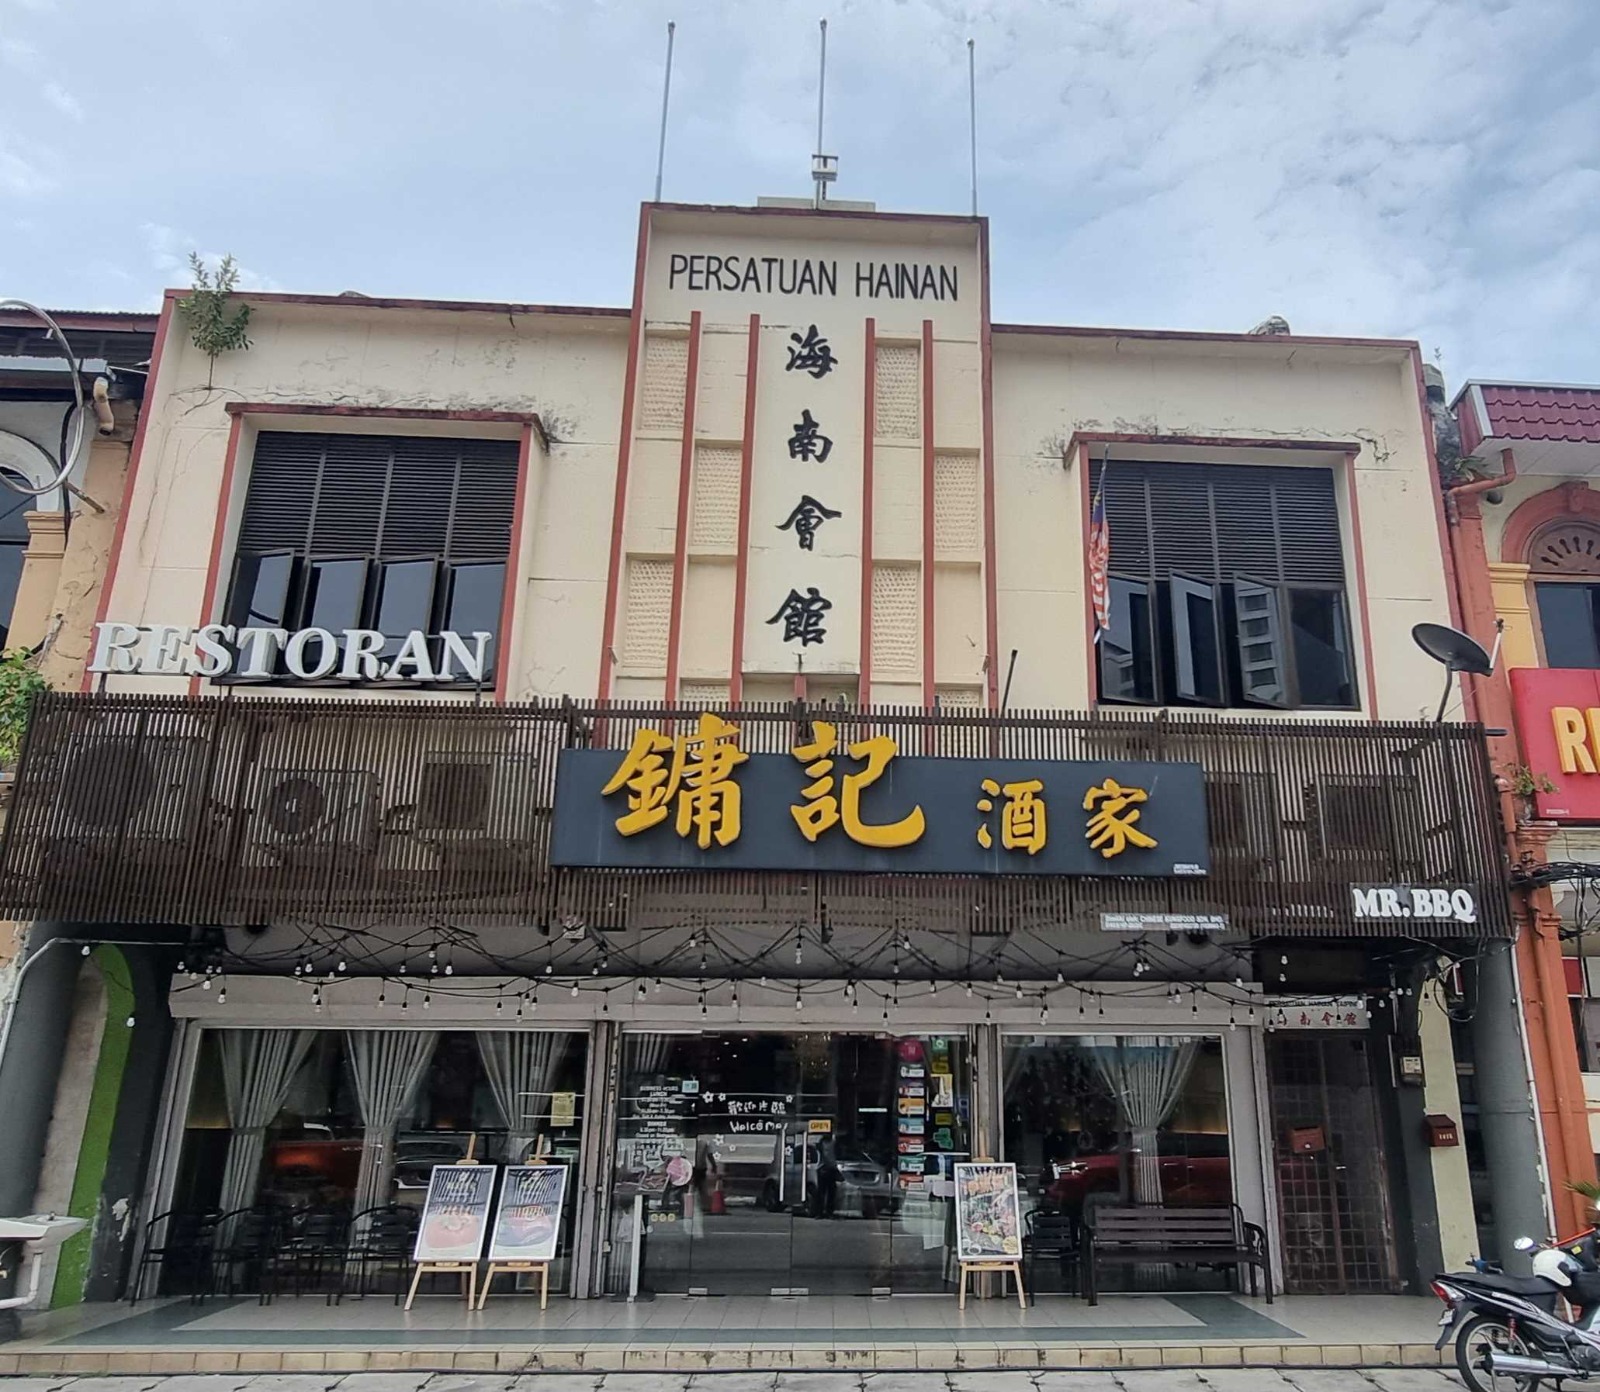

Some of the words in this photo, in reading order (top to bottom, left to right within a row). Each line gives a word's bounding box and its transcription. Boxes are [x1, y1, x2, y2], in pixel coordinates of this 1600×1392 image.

[669, 254, 838, 297] PERSATUAN
[855, 262, 959, 302] HAINAN
[766, 324, 842, 647] 海南會館
[87, 621, 492, 683] RESTORAN
[1352, 887, 1477, 923] MR.BBQ
